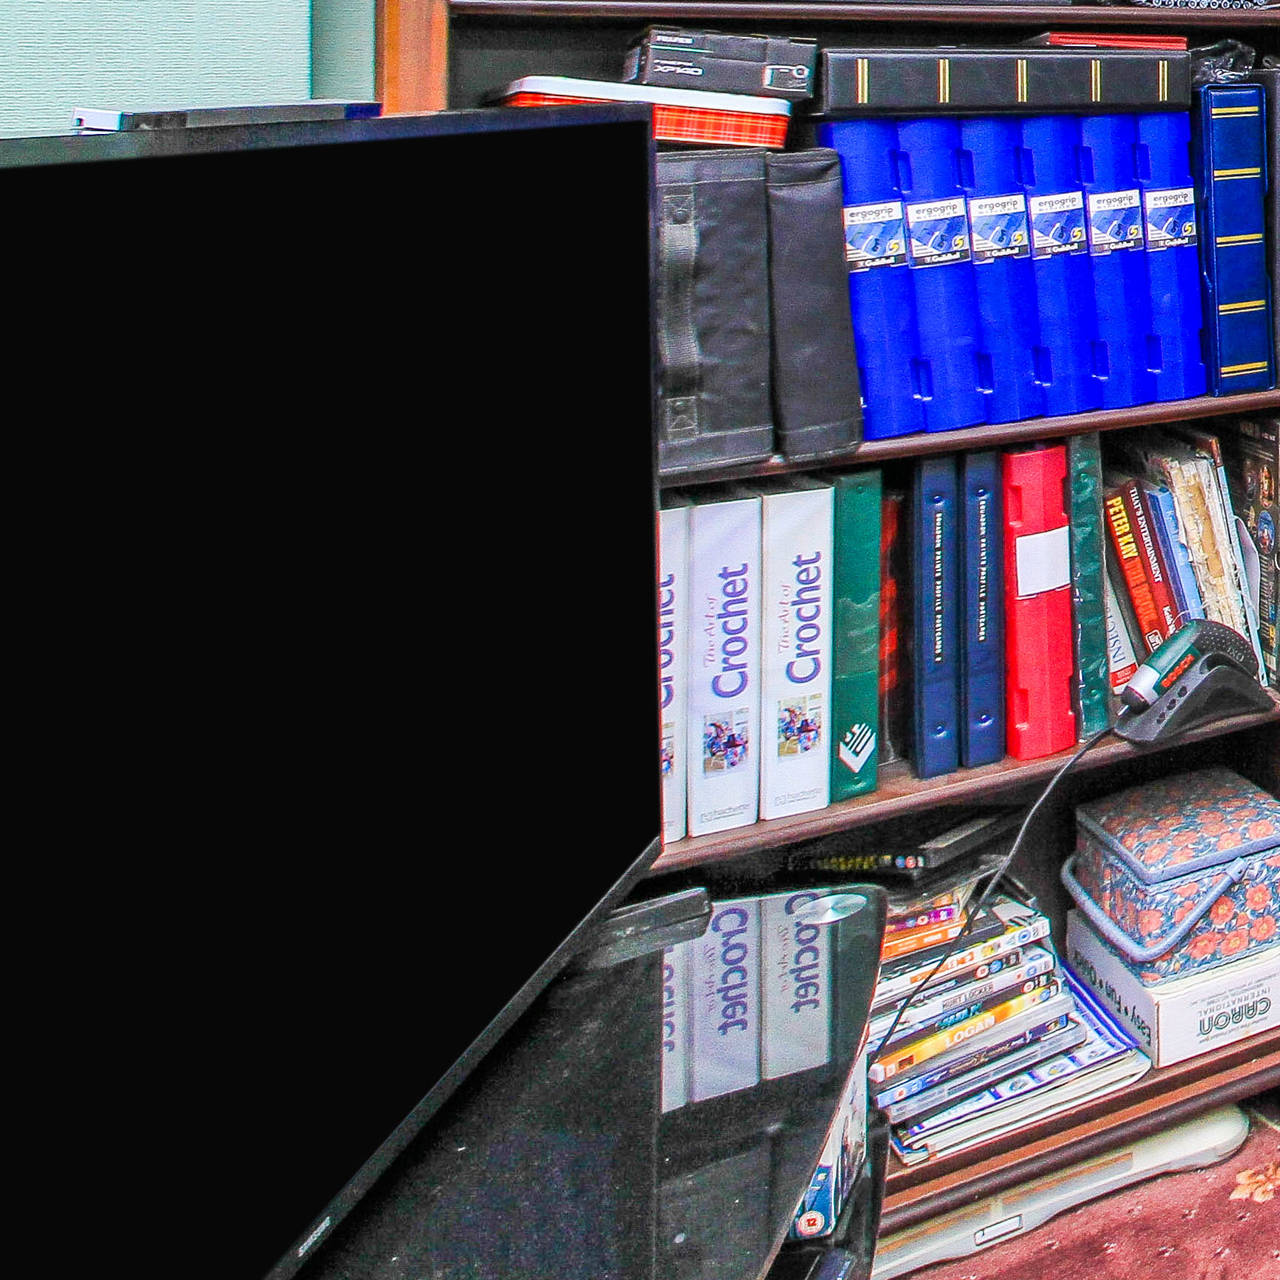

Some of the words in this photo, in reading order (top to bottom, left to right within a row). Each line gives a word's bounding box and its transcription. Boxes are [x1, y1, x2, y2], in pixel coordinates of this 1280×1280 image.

[915, 204, 958, 215] ergogrip
[978, 199, 1019, 210] ergogrip
[1038, 196, 1077, 208] ergogrip
[1096, 194, 1134, 205] ergogrip
[1153, 192, 1189, 202] ergogrip
[849, 207, 893, 219] ergogrip
[1106, 496, 1133, 535] PETER
[1116, 534, 1138, 560] KAY
[1128, 488, 1145, 516] THAT'S
[1137, 515, 1162, 583] ENTERTAINMENT
[704, 612, 716, 637] Art
[777, 600, 790, 624] Art
[784, 551, 822, 684] Crochet
[710, 563, 749, 698] Crochet
[777, 627, 790, 652] The
[704, 640, 716, 667] The
[1196, 986, 1271, 1017] INTERNATIONAL
[1199, 997, 1271, 1036] CARON
[945, 1014, 996, 1046] LOGAN
